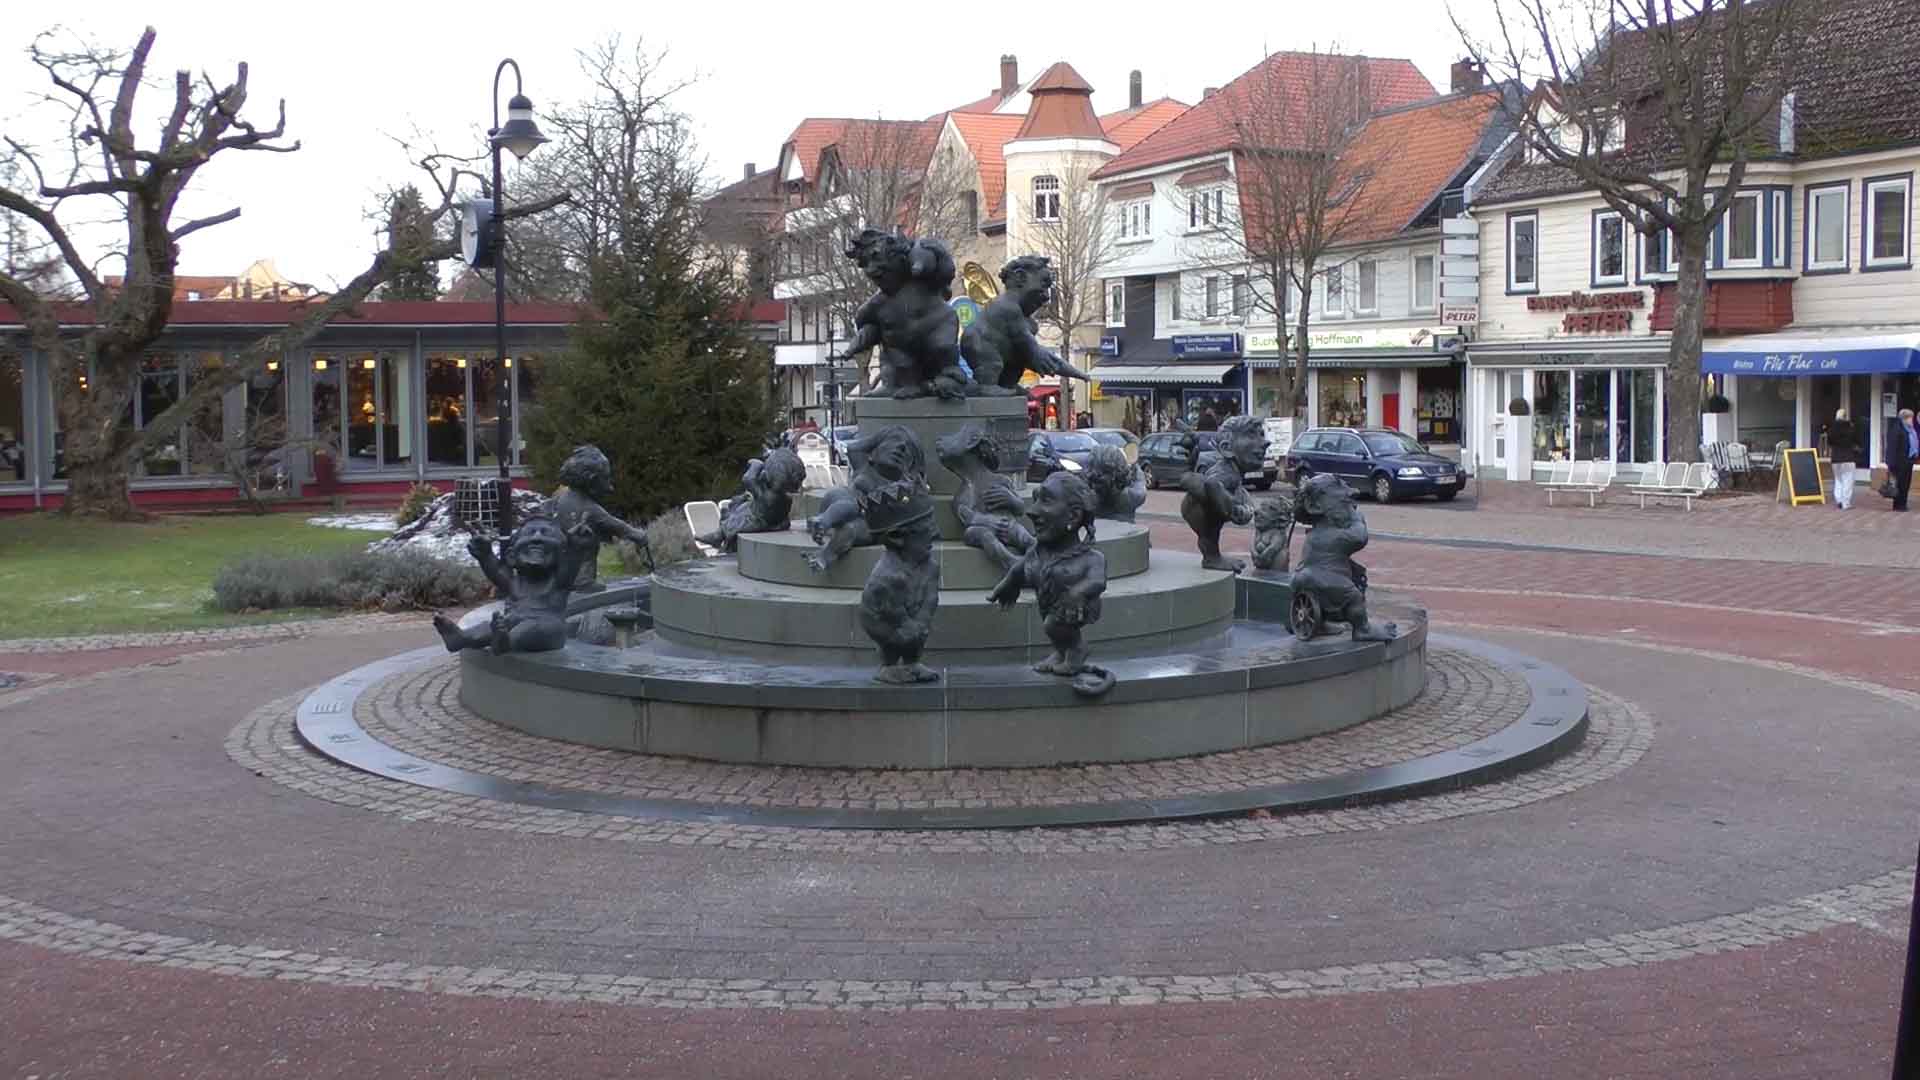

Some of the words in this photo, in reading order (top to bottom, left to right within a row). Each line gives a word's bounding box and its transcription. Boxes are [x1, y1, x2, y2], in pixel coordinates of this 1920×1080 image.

[1446, 312, 1477, 321] PETER
[1562, 311, 1633, 332] PETER
[1315, 333, 1363, 345] Hoffmann
